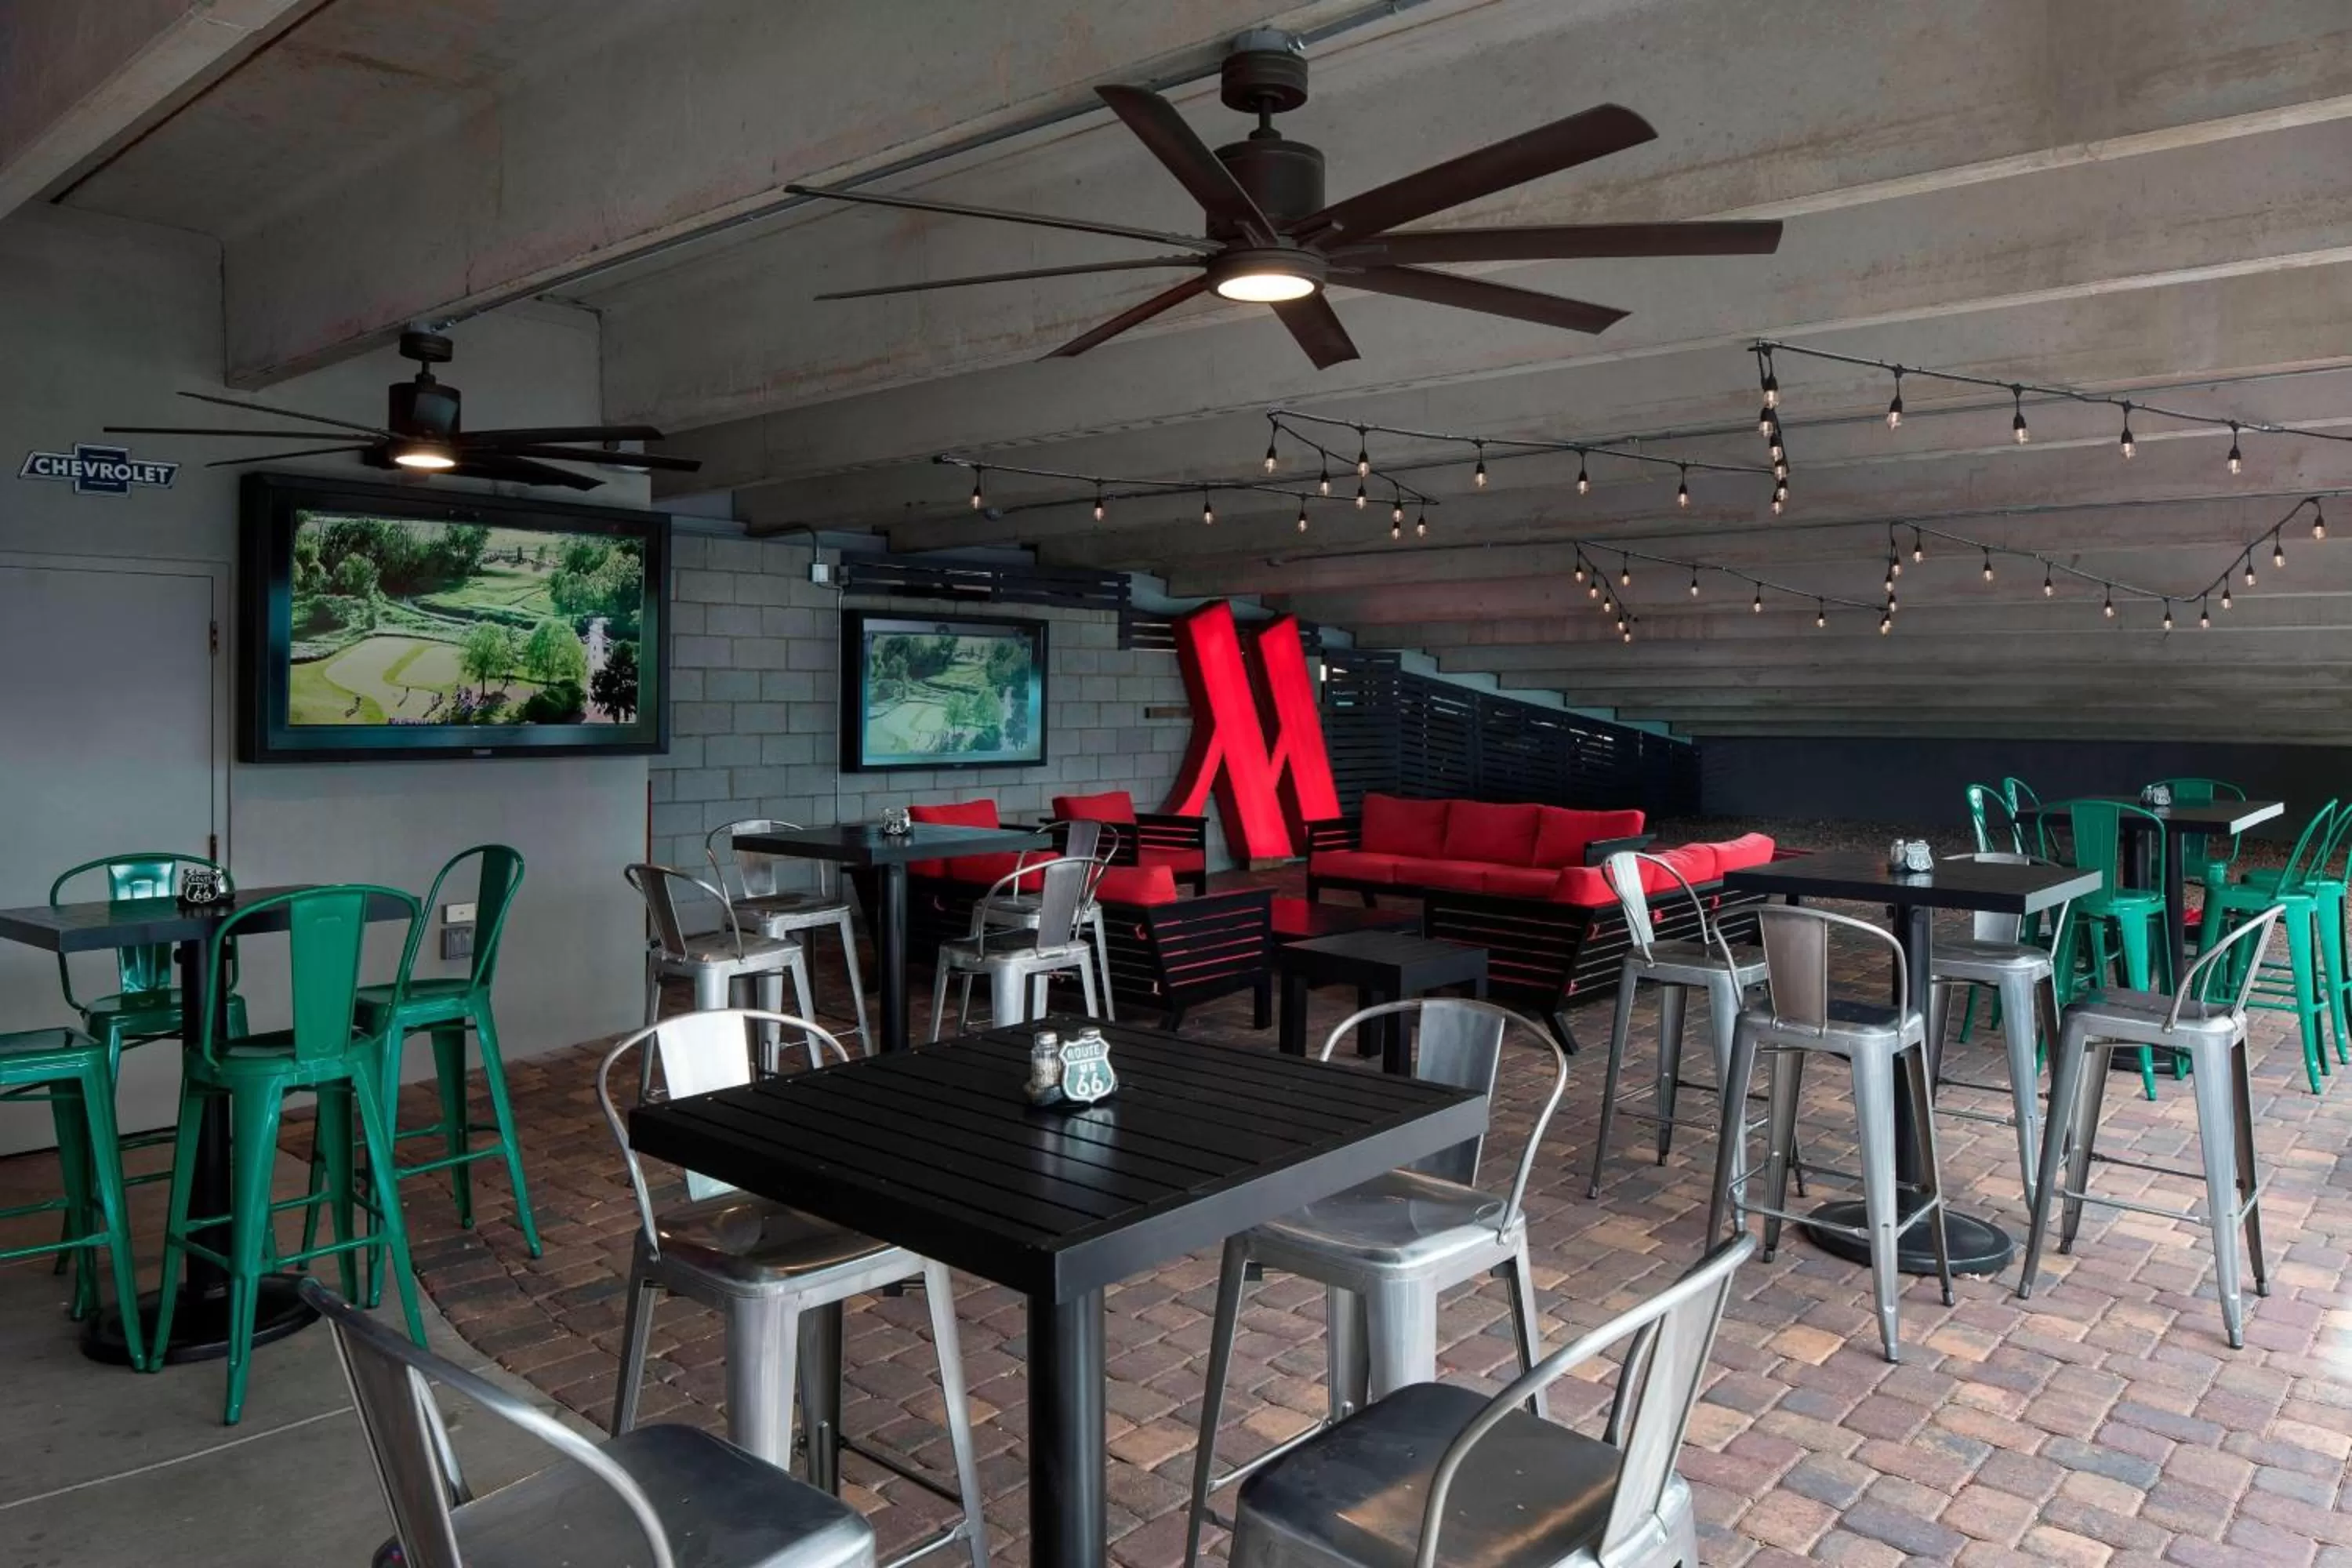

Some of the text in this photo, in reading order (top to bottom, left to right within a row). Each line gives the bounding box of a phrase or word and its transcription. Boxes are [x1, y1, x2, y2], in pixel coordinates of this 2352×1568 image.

[34, 458, 169, 483] CHEVROLET
[1067, 1044, 1101, 1060] ROUTE
[1076, 1073, 1103, 1094] 66
